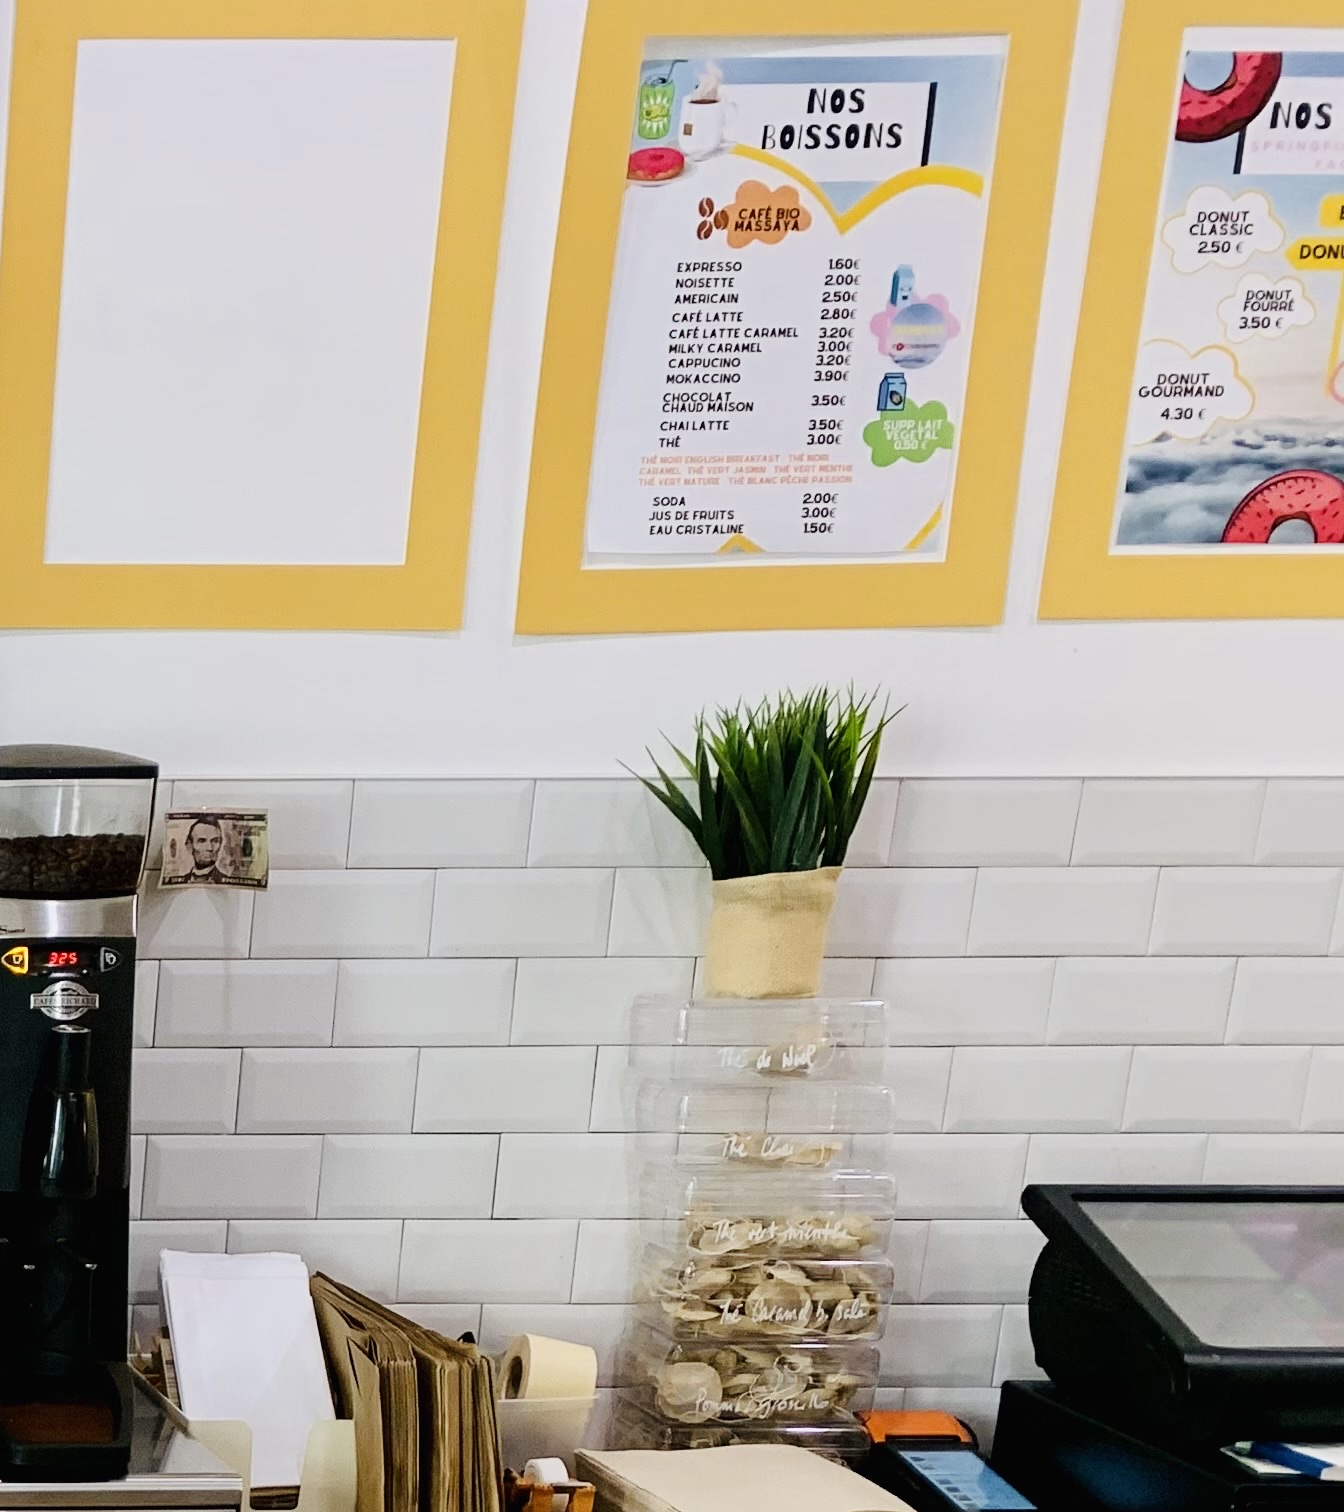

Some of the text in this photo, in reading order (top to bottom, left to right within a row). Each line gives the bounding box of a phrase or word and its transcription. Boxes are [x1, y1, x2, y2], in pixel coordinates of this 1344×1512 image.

[806, 87, 866, 114] NOS
[1269, 101, 1333, 130] NOS
[761, 122, 903, 150] BOISSONS
[738, 205, 801, 220] CAFÉ BIO
[1197, 210, 1250, 223] DONUT
[734, 219, 800, 232] MASSAYA
[1189, 223, 1254, 236] CLASSIC
[1197, 240, 1231, 254] 2.50
[676, 261, 743, 273] EXPRESSO
[675, 277, 735, 289] NOISETTE
[674, 293, 739, 305] AMERICAIN
[1245, 289, 1292, 301] DONUT
[1243, 297, 1295, 312] FOURRÉ
[672, 309, 702, 323] CAFÉ
[705, 311, 743, 323] LATTE
[1239, 316, 1271, 330] 3.50
[668, 325, 699, 340] CAFÉ
[702, 327, 741, 339] LATTE
[744, 327, 799, 338] CARAMEL
[668, 343, 704, 354] MILKY
[707, 342, 762, 353] CARAMEL
[668, 357, 741, 369] CAPPUCINO
[666, 373, 741, 384] MOKACCINO
[1156, 372, 1210, 385] DONUT
[662, 391, 732, 403] CHOCOLAT
[1138, 385, 1225, 398] GOURMAND
[662, 401, 754, 413] CHAUD MAISON
[1160, 407, 1194, 420] 4.30
[659, 420, 689, 432] CHAI
[692, 420, 730, 431] LATTE
[918, 419, 943, 430] LAIT
[659, 435, 681, 448] THÉ
[652, 496, 686, 507] SODA
[649, 511, 671, 521] JUS
[675, 510, 689, 521] DE
[693, 510, 735, 520] FRUITS
[649, 525, 673, 535] EAU
[676, 524, 744, 535] CRISTALINE
